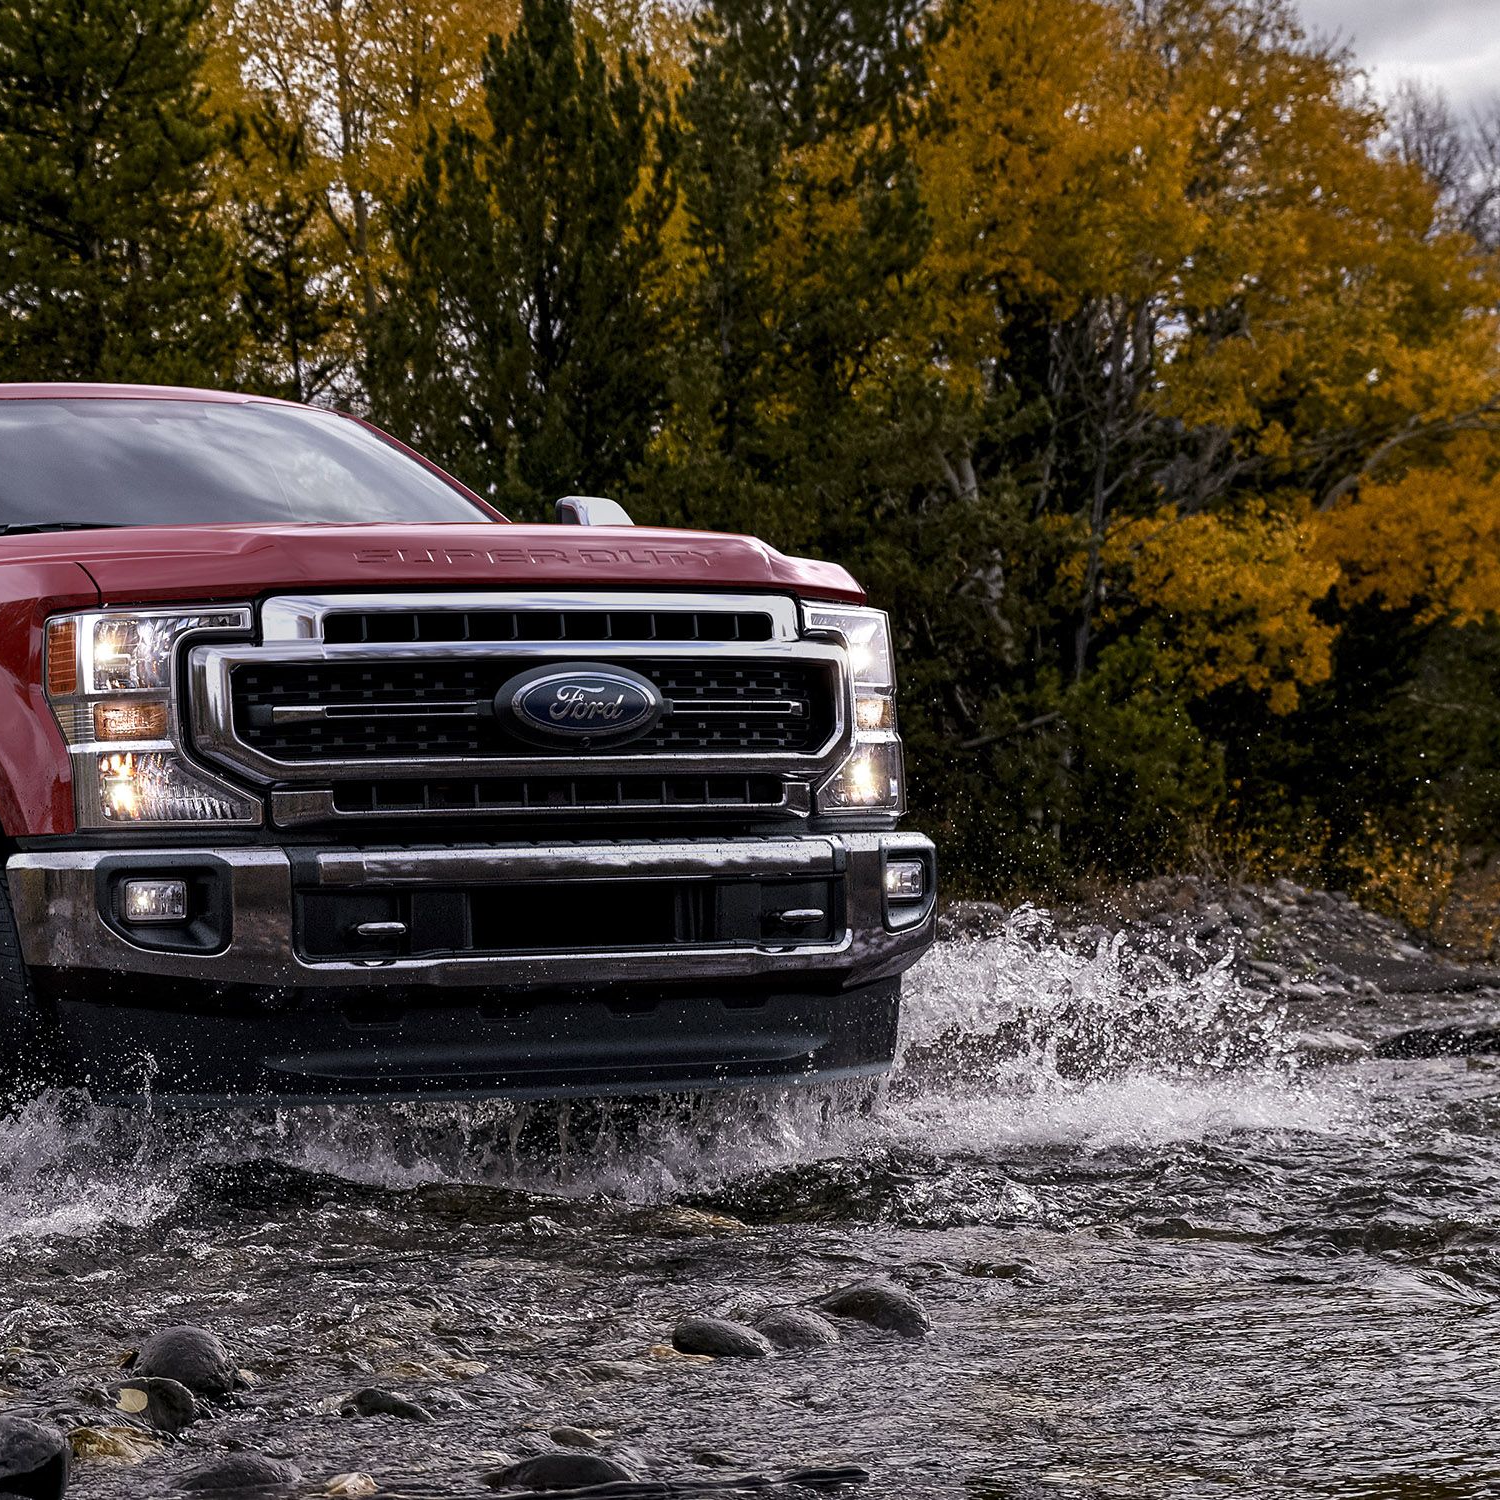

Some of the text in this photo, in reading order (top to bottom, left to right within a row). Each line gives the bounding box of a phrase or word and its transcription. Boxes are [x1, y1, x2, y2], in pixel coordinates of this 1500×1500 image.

[352, 548, 722, 566] SUPER DUTY
[549, 684, 624, 720] Ford
